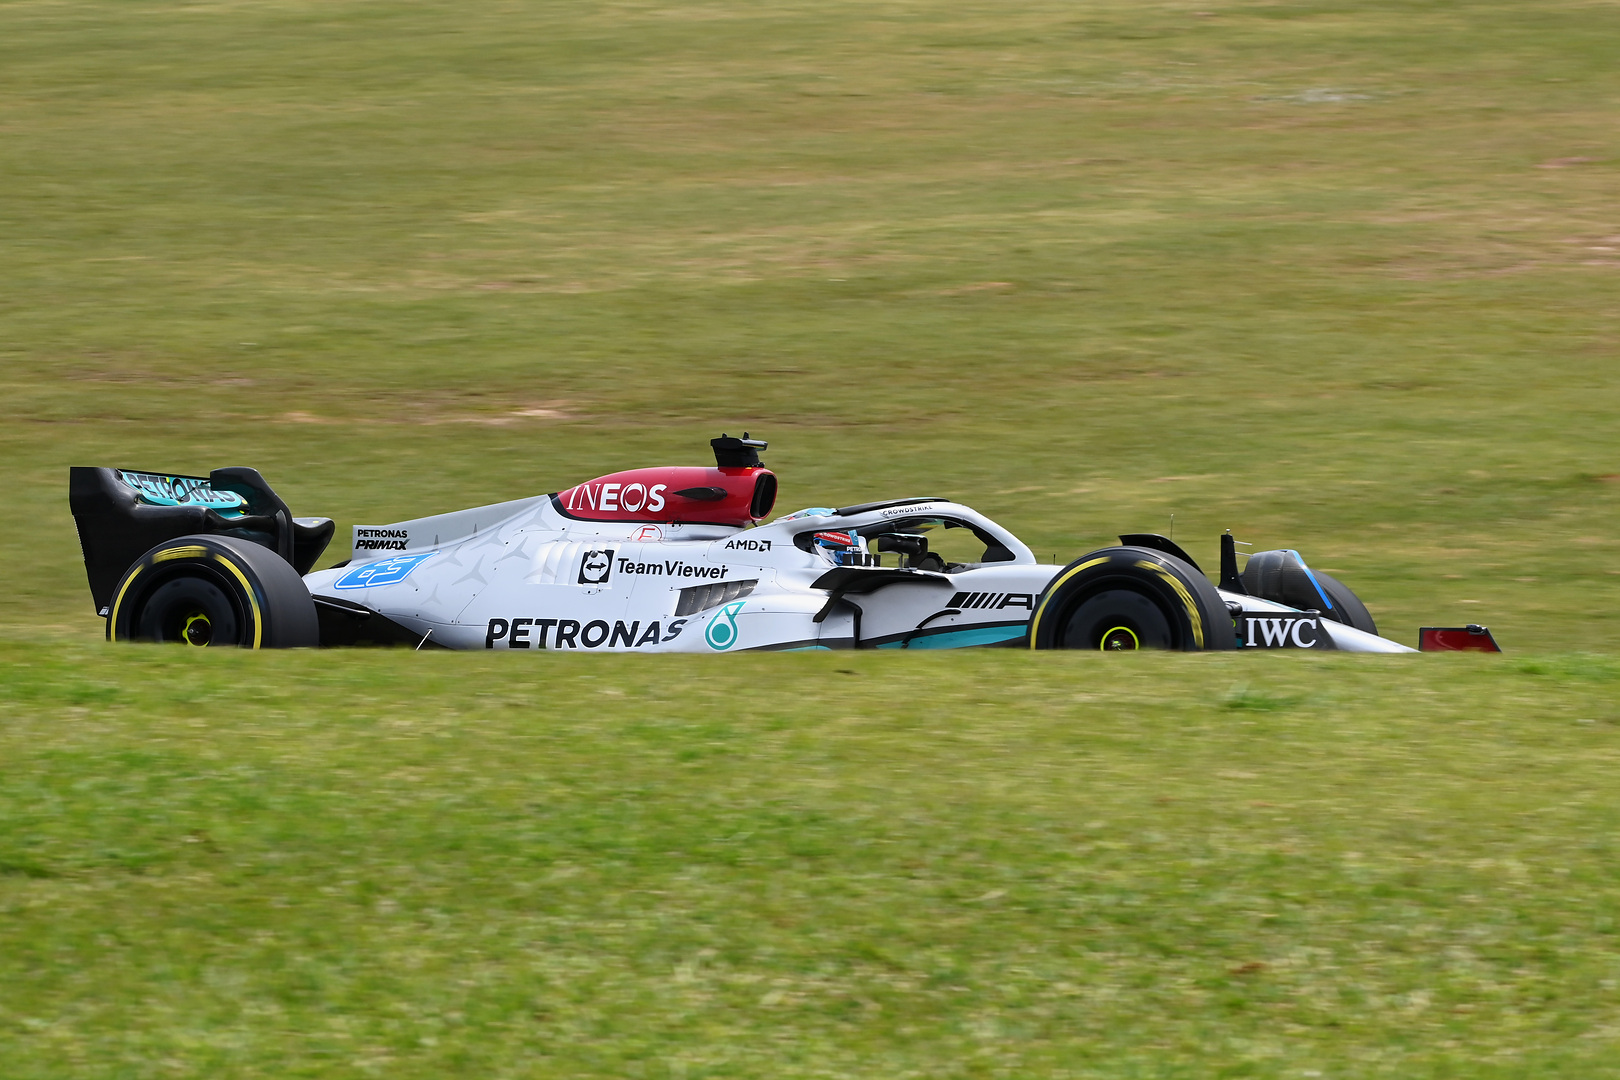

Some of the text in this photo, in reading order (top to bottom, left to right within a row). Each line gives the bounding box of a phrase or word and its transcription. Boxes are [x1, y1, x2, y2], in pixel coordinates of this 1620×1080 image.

[567, 482, 667, 512] INEOS
[355, 538, 410, 551] PRIMAX
[357, 529, 408, 539] PETRONAS
[724, 539, 759, 551] AMD
[617, 557, 729, 579] TeamViewer
[485, 617, 688, 650] PETRONAS
[1245, 617, 1318, 648] IWC
